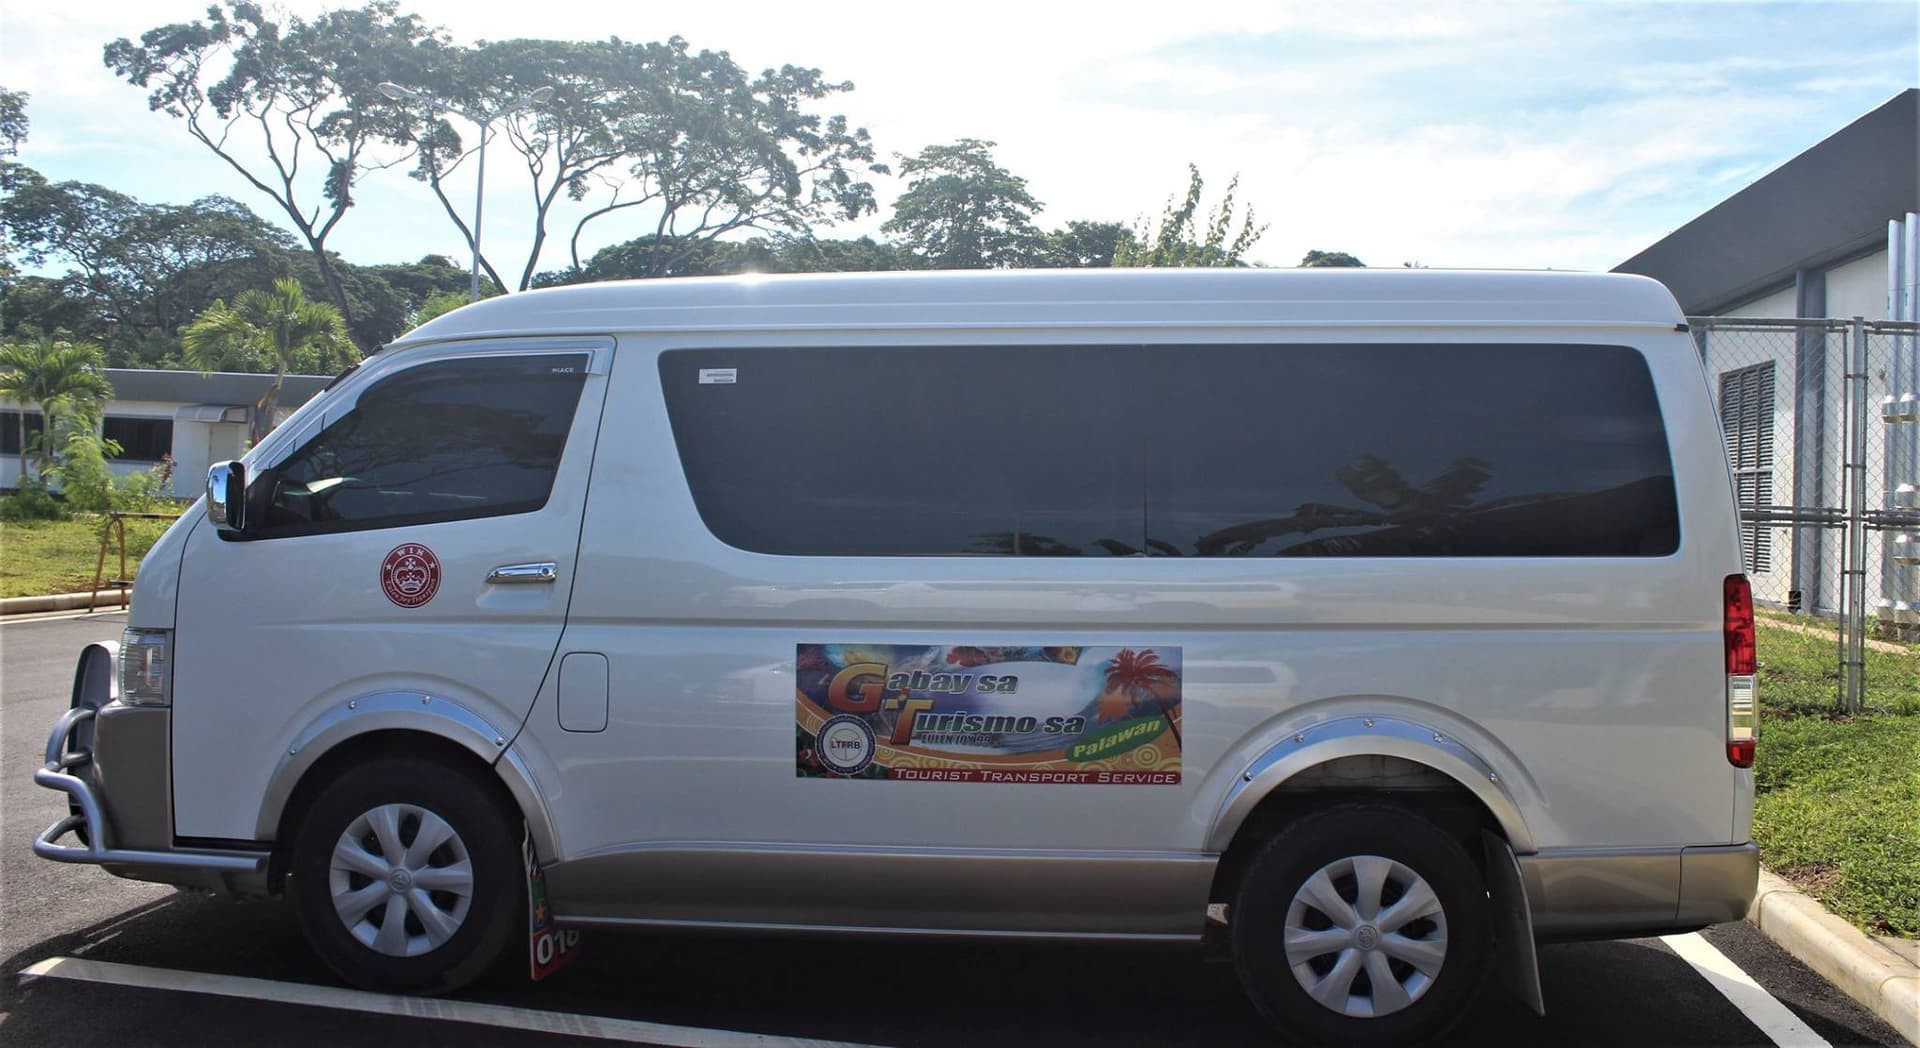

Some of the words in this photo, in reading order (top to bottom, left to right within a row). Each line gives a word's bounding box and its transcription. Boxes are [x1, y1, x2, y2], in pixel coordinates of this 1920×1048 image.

[397, 547, 424, 556] WIN
[828, 662, 973, 713] Gabay
[976, 672, 1019, 695] sa
[884, 698, 1038, 746] Turismo
[1043, 714, 1087, 736] sa
[831, 740, 861, 749] LTFRB
[1073, 719, 1161, 758] Palawan
[895, 768, 972, 782] TOURIST
[980, 770, 1090, 784] TRANSPORT
[1097, 771, 1177, 784] SERVICE
